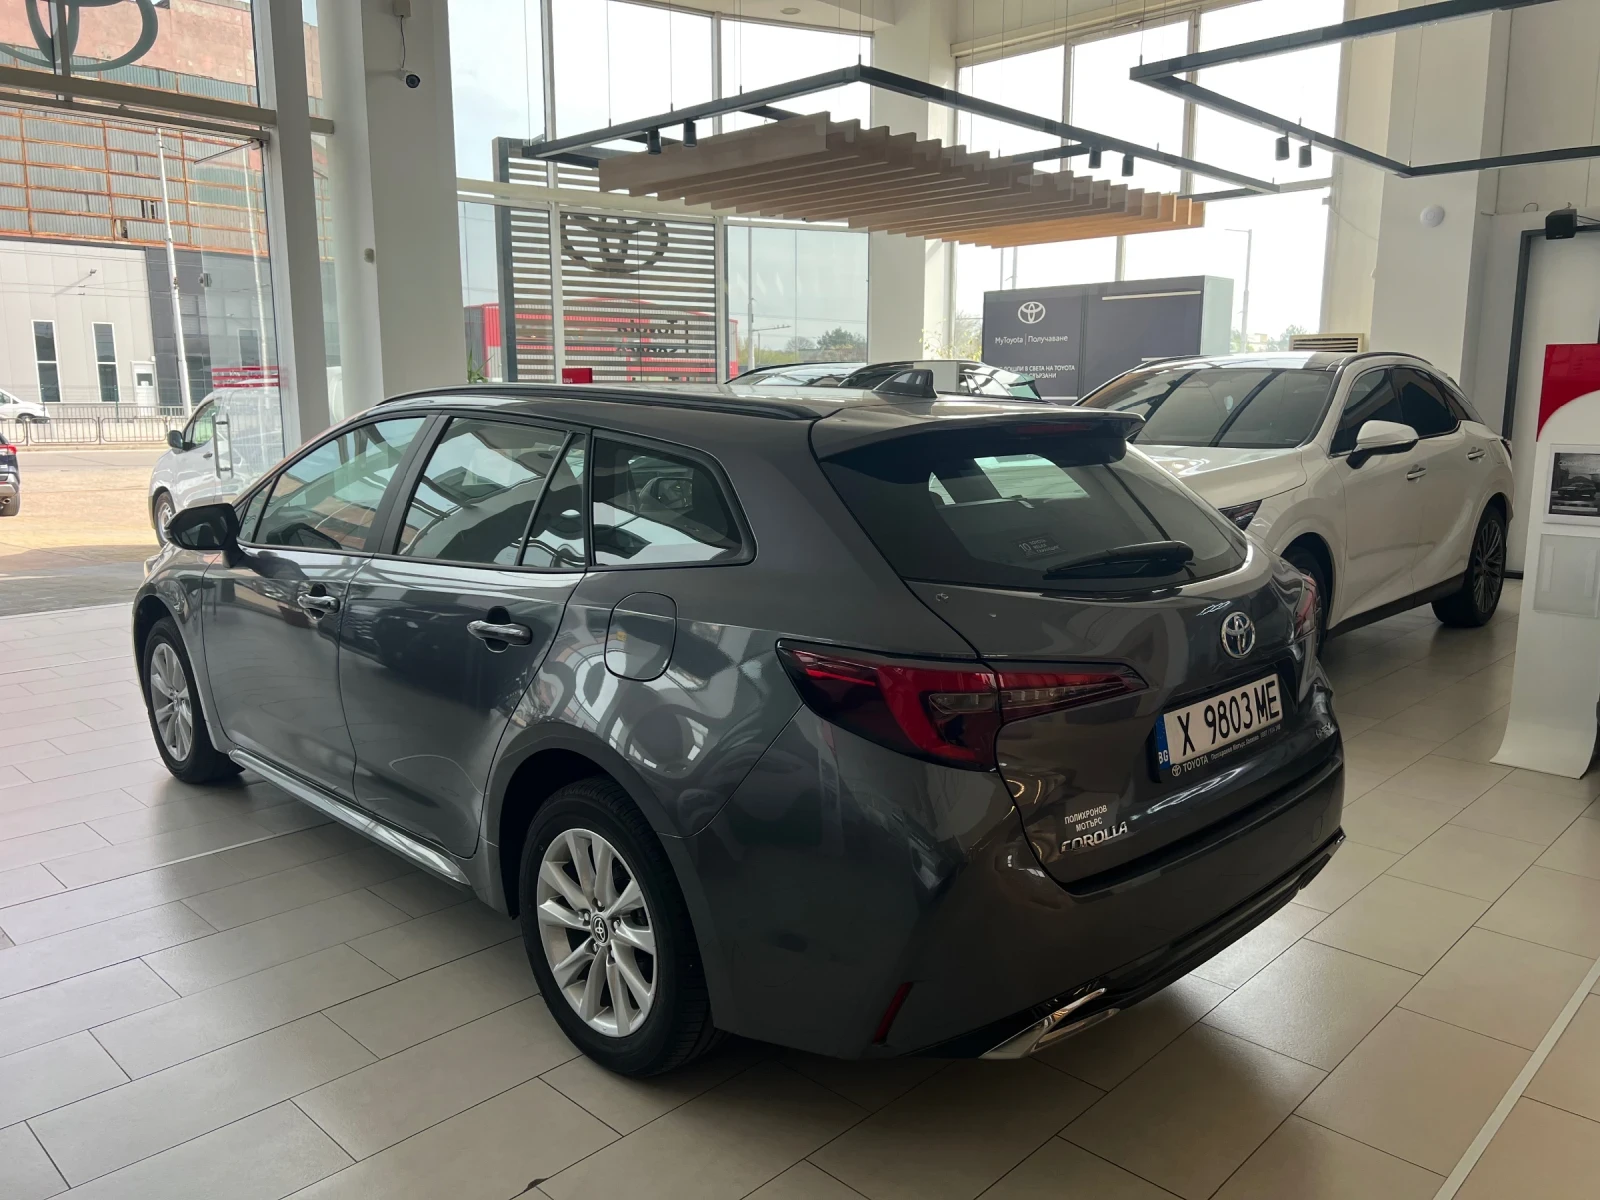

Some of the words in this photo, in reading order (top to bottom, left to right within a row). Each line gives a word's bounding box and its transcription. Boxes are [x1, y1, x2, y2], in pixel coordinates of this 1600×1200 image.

[995, 336, 1023, 345] MyToyota
[1028, 335, 1068, 344] Получаване
[1019, 543, 1031, 551] 10
[1177, 712, 1196, 756] X
[1204, 691, 1253, 745] 9803
[1254, 680, 1280, 724] ME
[1158, 750, 1169, 765] BG
[1183, 755, 1209, 772] TOYOTA
[1064, 804, 1108, 825] ПОЛИХРОНОВ
[1075, 816, 1103, 832] МОТЪРС
[1060, 821, 1128, 853] COROLLA
